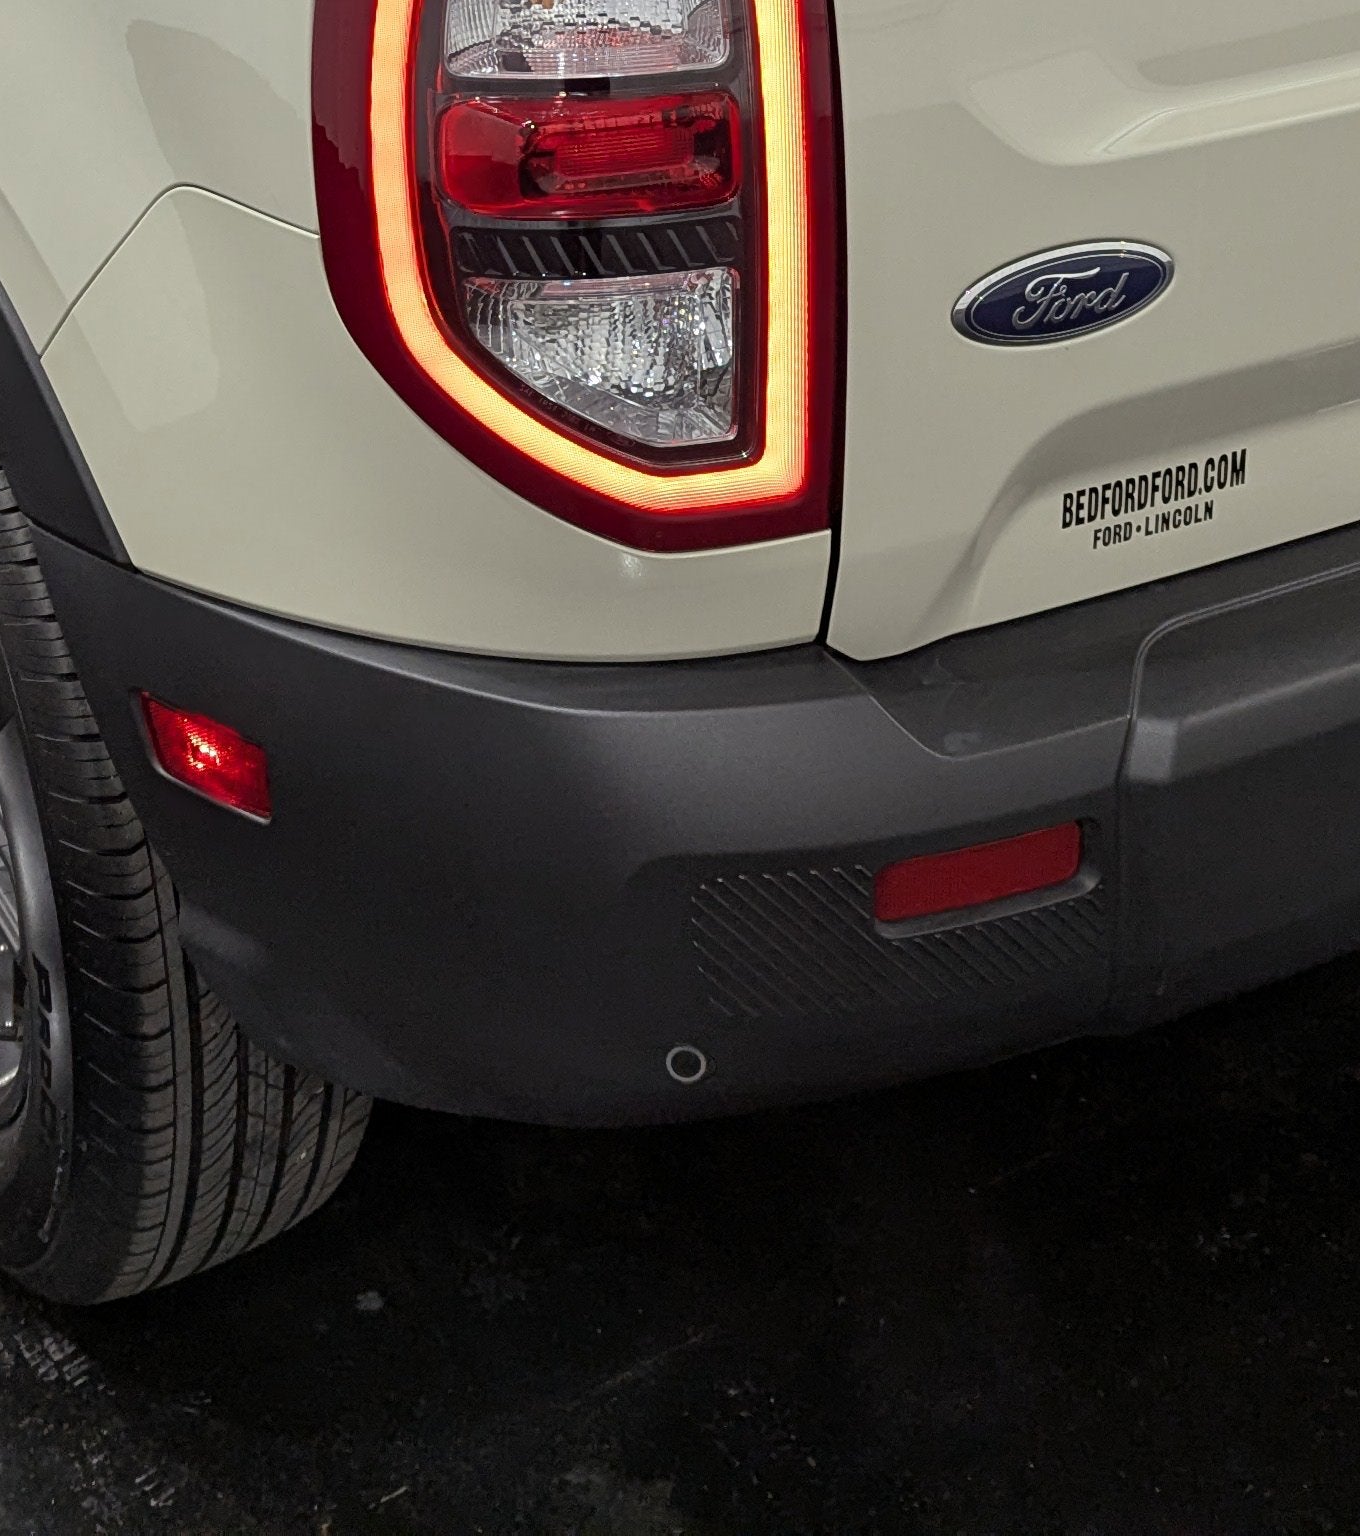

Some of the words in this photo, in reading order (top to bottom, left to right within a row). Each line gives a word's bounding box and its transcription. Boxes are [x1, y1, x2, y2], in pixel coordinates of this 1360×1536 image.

[1011, 266, 1130, 331] Ford
[1061, 448, 1248, 530] BEDFORDFORD.COM
[1092, 520, 1133, 550] FORD
[1144, 499, 1215, 537] LINCOLN
